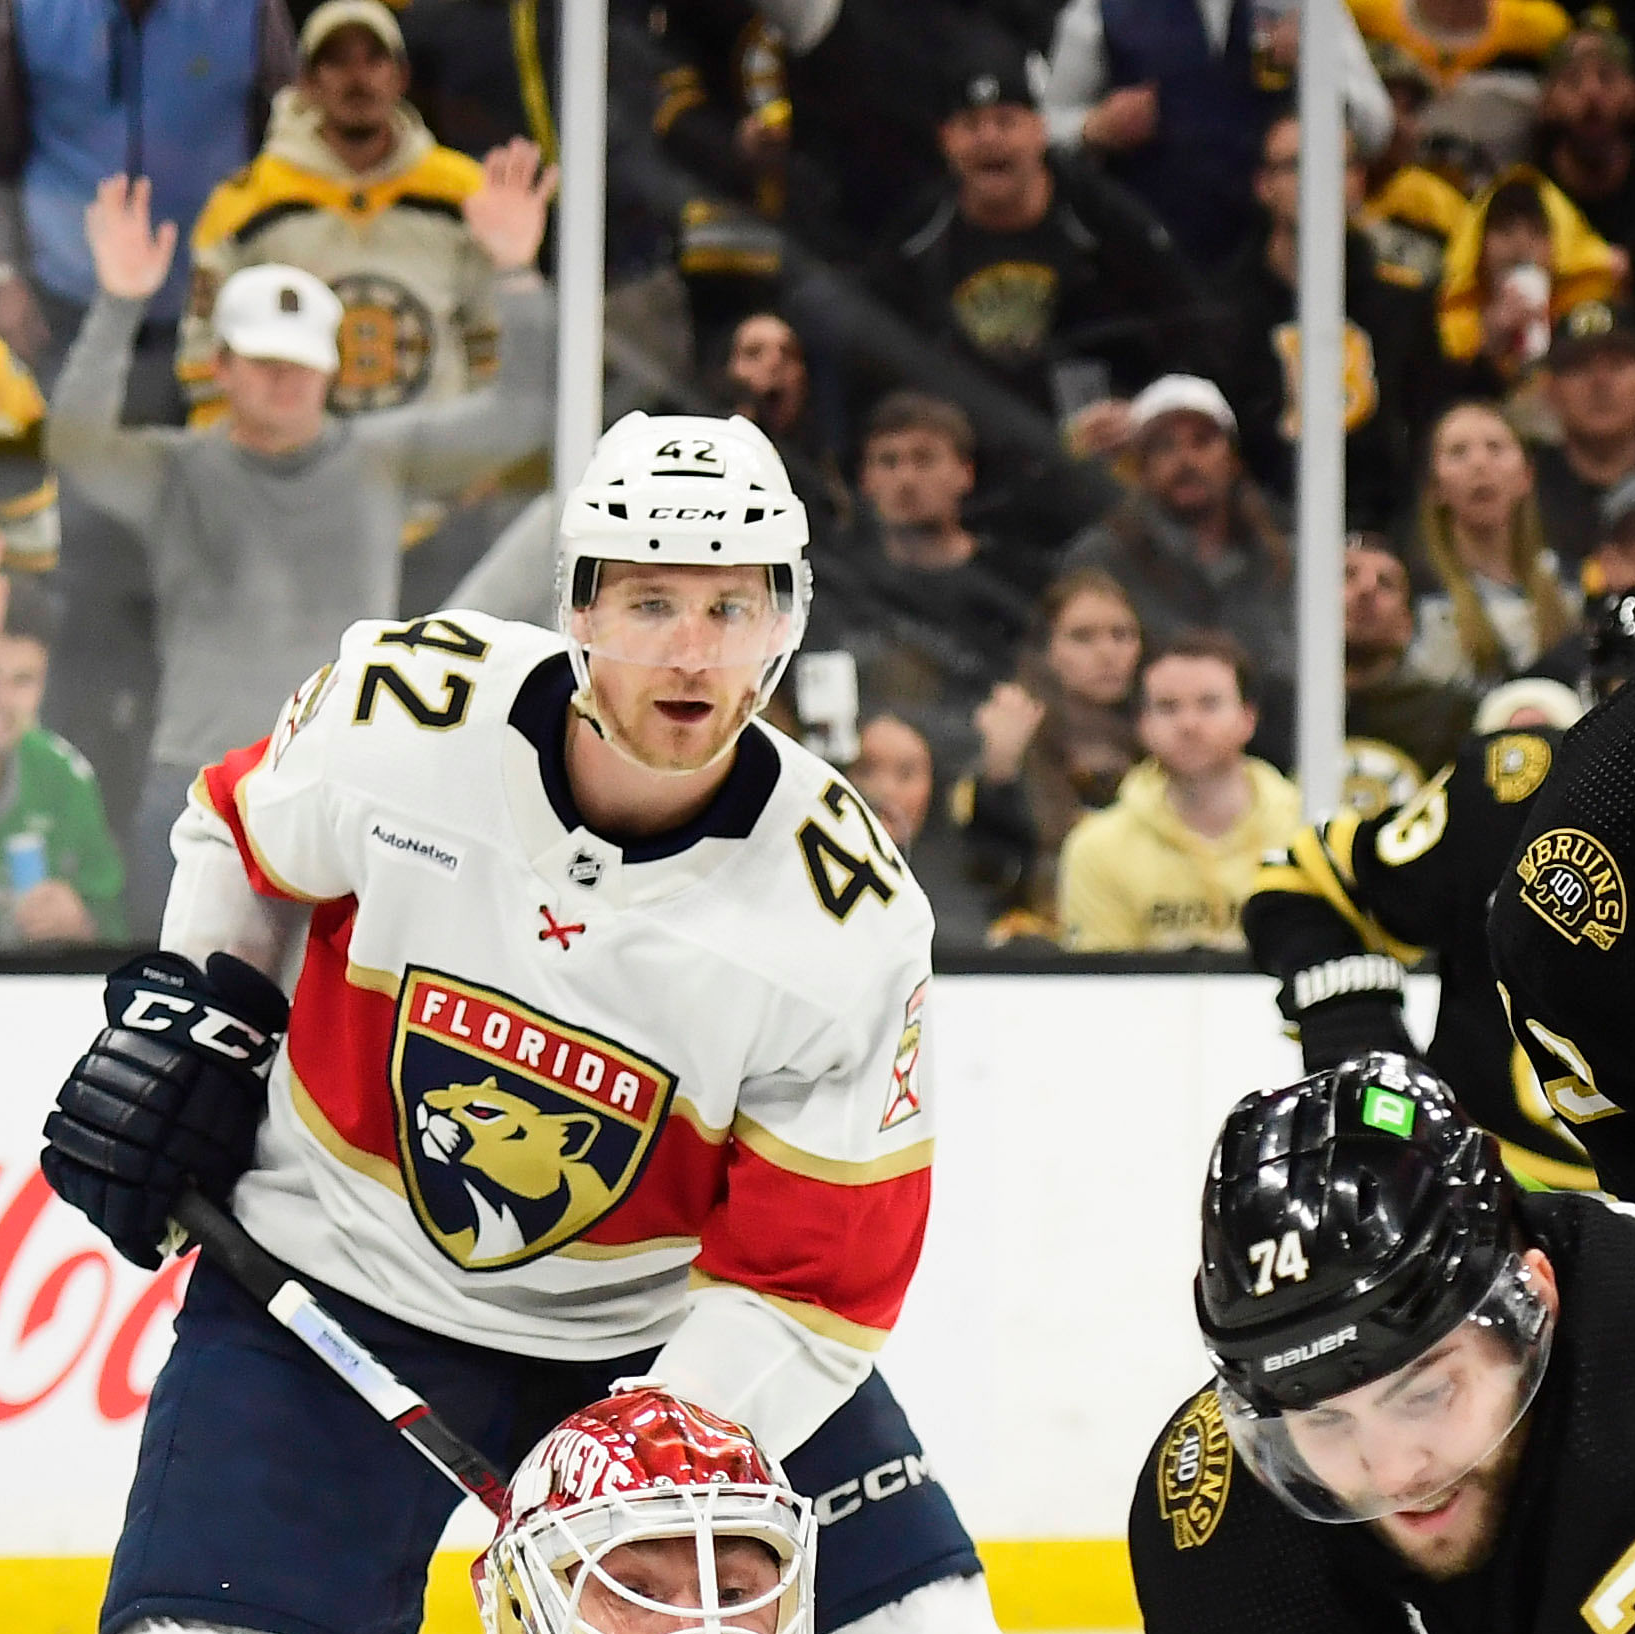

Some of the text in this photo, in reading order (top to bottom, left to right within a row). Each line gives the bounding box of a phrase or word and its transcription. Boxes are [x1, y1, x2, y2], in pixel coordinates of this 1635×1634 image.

[654, 439, 717, 463] 42
[648, 507, 727, 521] CCM
[351, 617, 492, 732] 42
[371, 824, 459, 872] AutoNation
[1535, 835, 1620, 921] BRUINS
[1550, 869, 1583, 906] 100
[121, 989, 283, 1081] CC
[420, 989, 641, 1112] FLORIDA
[1248, 1230, 1309, 1297] 74
[1263, 1325, 1358, 1372] BAUER
[1178, 1435, 1200, 1482] 100
